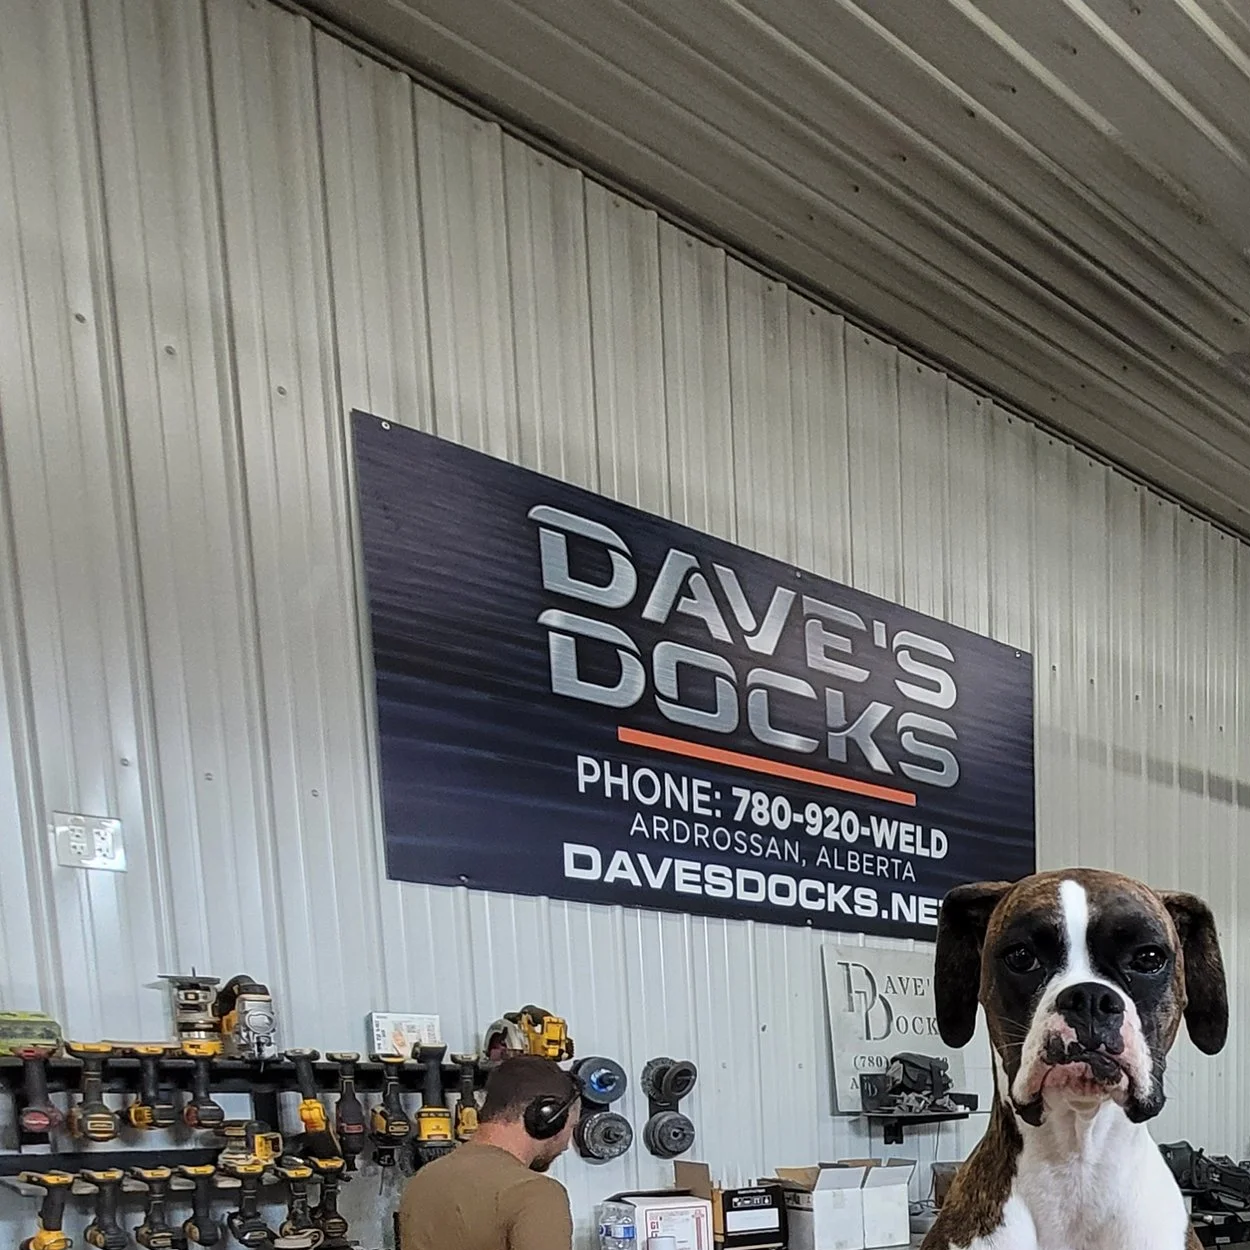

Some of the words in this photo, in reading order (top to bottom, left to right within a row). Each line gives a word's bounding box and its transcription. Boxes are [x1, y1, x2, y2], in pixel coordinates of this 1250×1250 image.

[527, 504, 957, 709] DAVE'S
[537, 609, 960, 788] DOCKS
[577, 754, 722, 818] PHONE:
[732, 786, 948, 859] 780-920-WELD
[630, 812, 806, 867] ARDROSSAN,
[816, 846, 916, 882] ALBERTA
[563, 842, 943, 926] DAVESDOCKS.NE
[837, 961, 930, 1013] DAVE'
[854, 993, 939, 1041] DOCK
